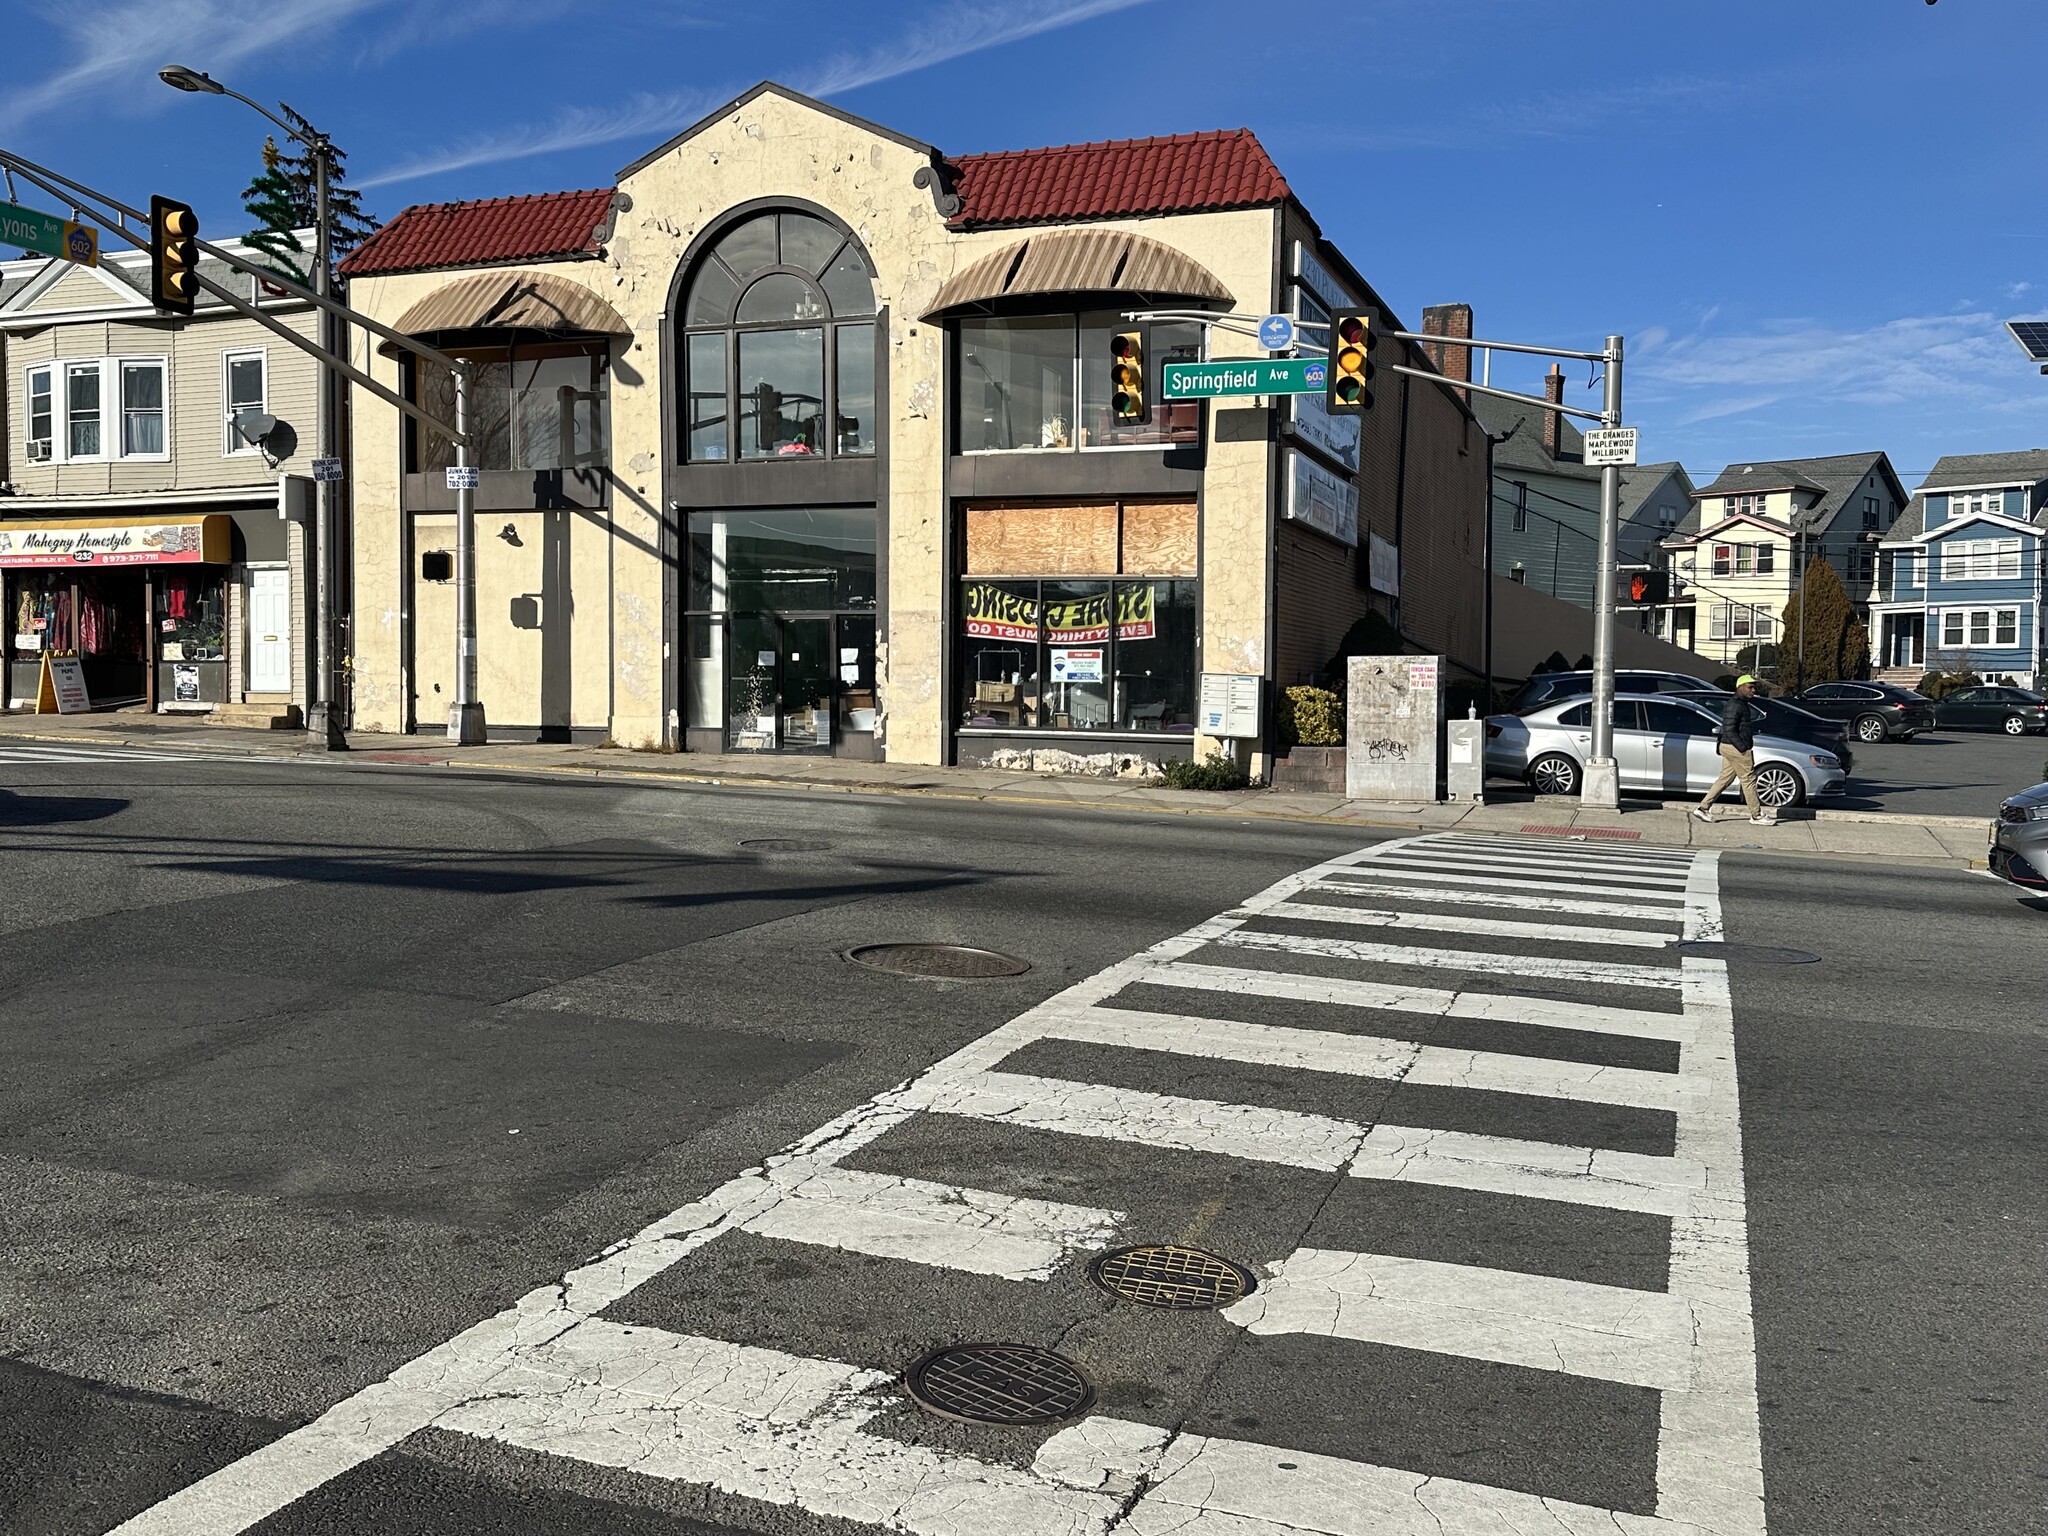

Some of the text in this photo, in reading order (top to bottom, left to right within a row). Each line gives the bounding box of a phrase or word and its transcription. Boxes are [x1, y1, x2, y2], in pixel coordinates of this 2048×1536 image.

[0, 216, 58, 240] yons Ave
[71, 240, 90, 255] 602
[1171, 368, 1289, 394] Springfield Ave
[1306, 371, 1324, 381] 603
[1603, 430, 1634, 439] ORANGES
[1588, 440, 1634, 448] MAPLEWOOD
[1592, 449, 1629, 457] MILLBURN
[75, 530, 132, 551] Homestyle
[1141, 1269, 1204, 1285] GAS
[970, 1369, 1036, 1397] GAS
